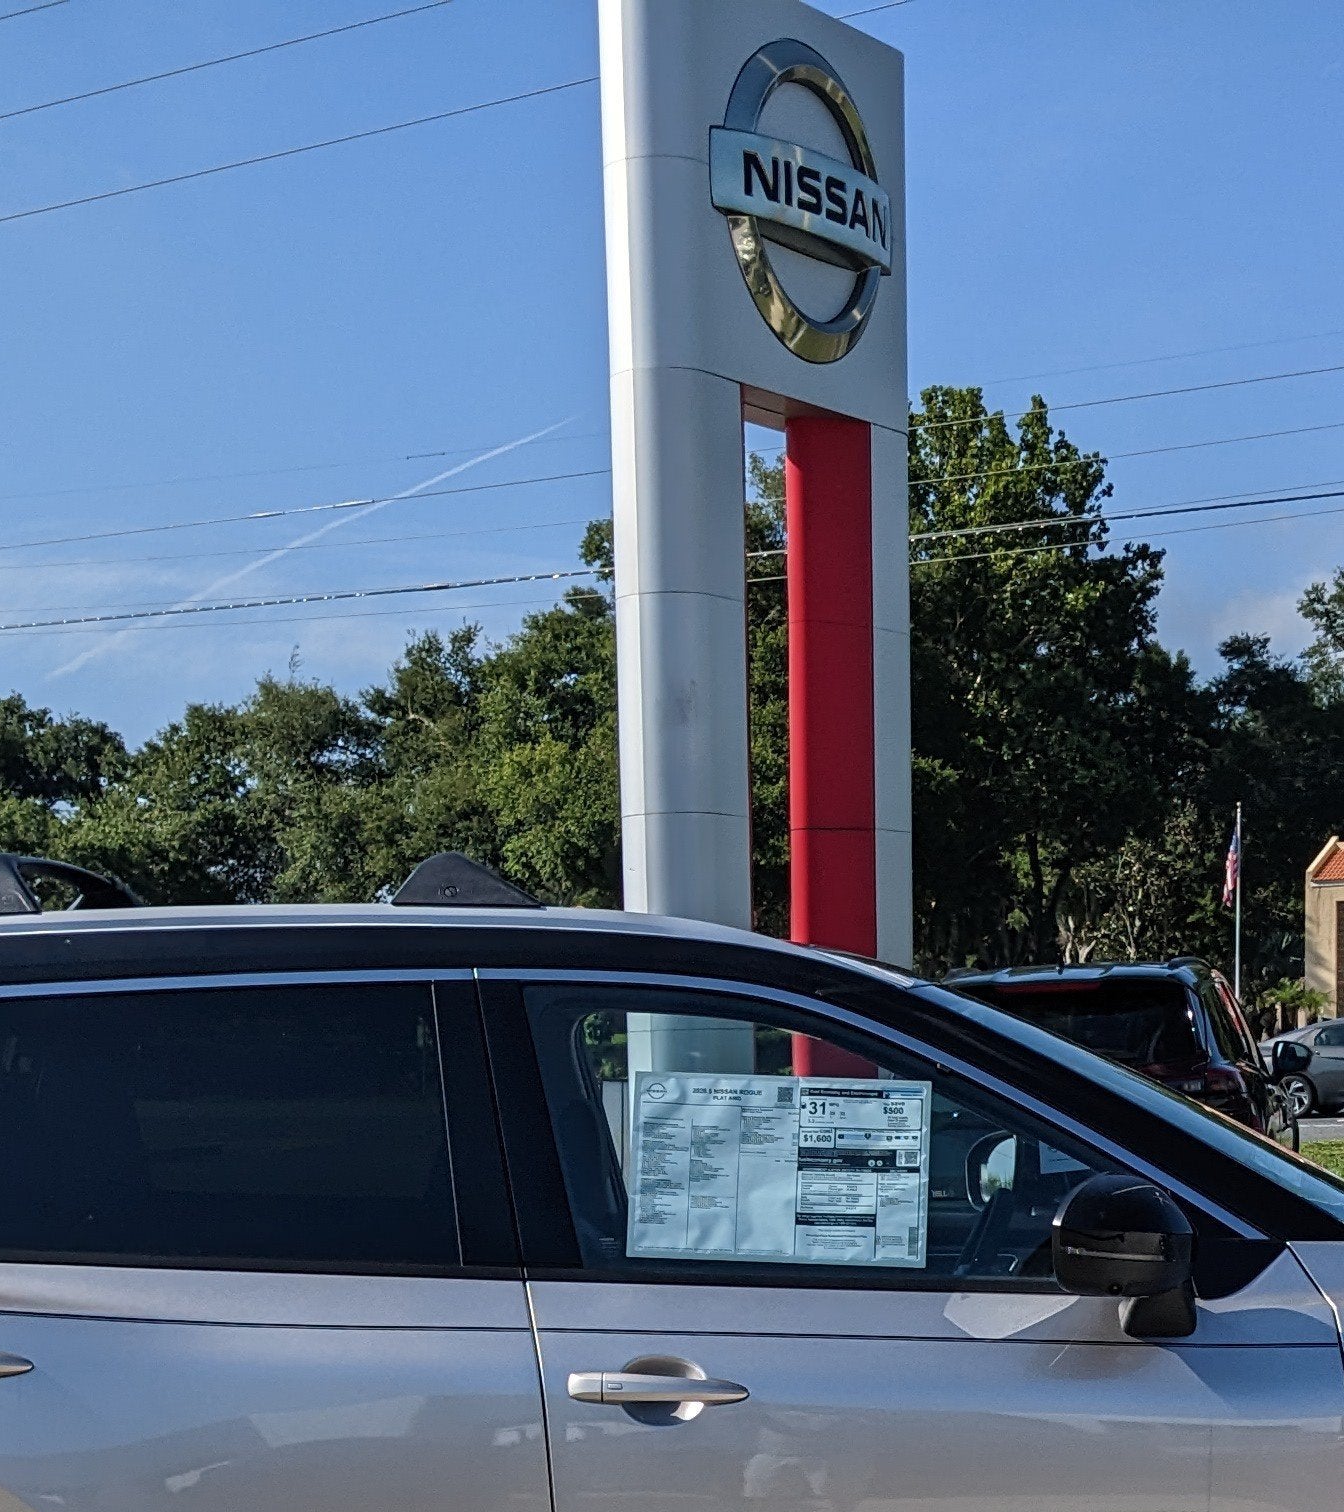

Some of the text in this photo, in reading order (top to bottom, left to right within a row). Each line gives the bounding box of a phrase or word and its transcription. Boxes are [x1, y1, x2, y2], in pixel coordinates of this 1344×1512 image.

[742, 150, 889, 251] NISSAN
[808, 1101, 826, 1115] 31
[803, 1133, 832, 1143] $1,600
